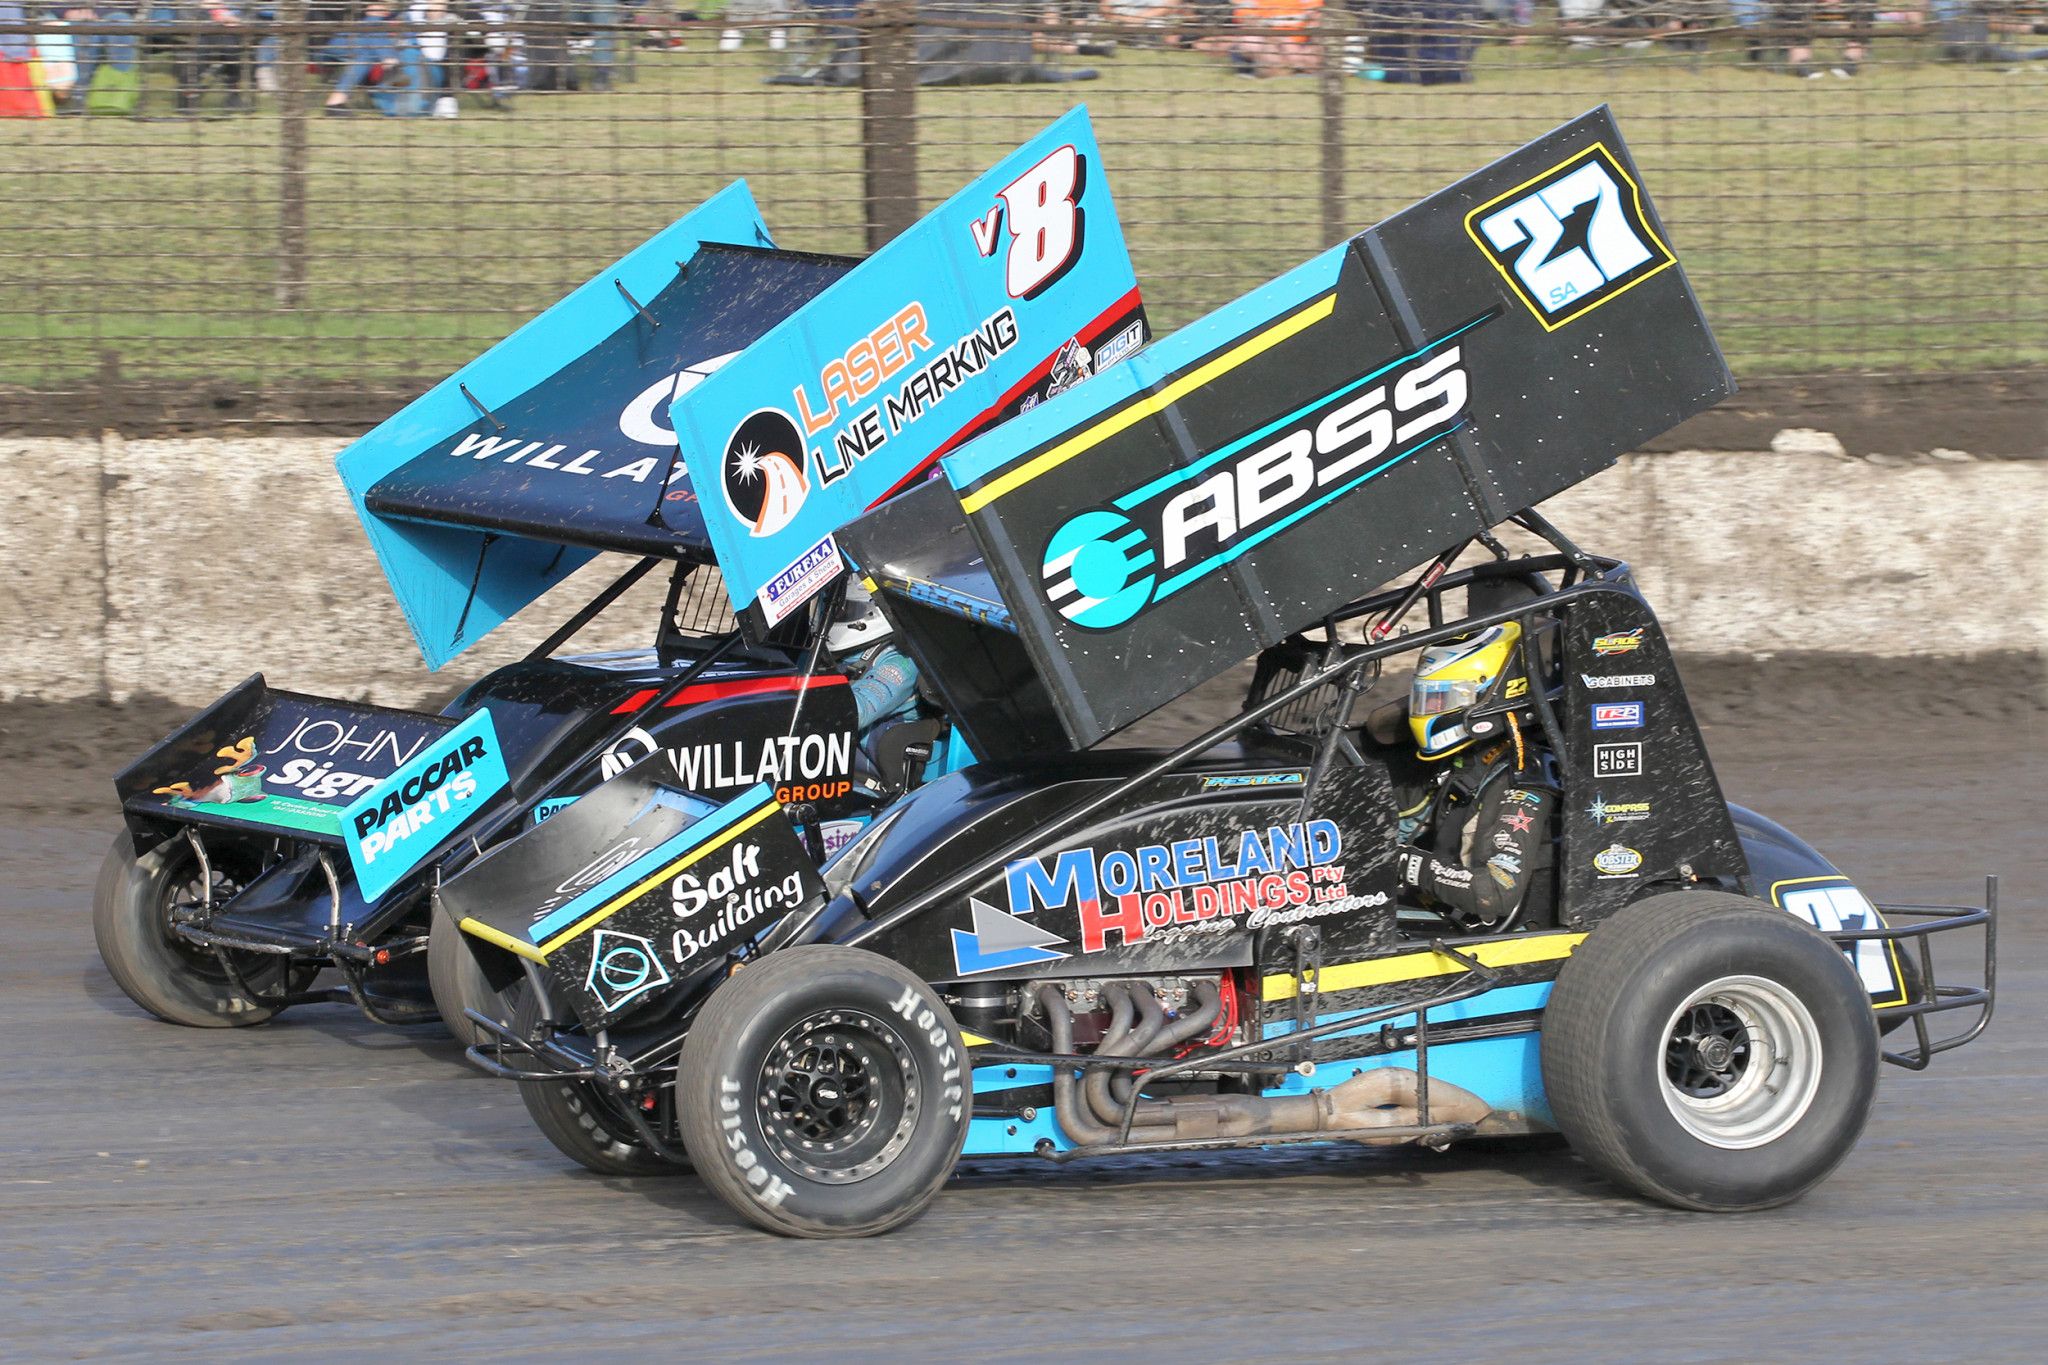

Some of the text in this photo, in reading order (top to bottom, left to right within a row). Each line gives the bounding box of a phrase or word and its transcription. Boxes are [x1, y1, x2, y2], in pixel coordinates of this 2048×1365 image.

[1479, 159, 1653, 314] 27
[1549, 280, 1578, 306] SA
[795, 302, 934, 434] LASER
[815, 308, 1018, 488] LINE MARKING
[1163, 345, 1467, 569] ABSS
[774, 543, 833, 595] EUREKA
[779, 583, 808, 607] Garages
[814, 560, 835, 579] Sheds
[265, 717, 426, 767] JOHN
[667, 731, 851, 791] WILLATON
[1600, 749, 1636, 761] HIGH
[1600, 759, 1636, 771] SIDE
[354, 736, 487, 840] PACCAR
[776, 781, 851, 804] GROUP
[1605, 803, 1650, 813] COMPASS
[360, 770, 477, 865] PARTS
[672, 842, 760, 917] Salt
[1005, 818, 1342, 914] MORELAND
[1312, 866, 1345, 885] Pty
[1314, 884, 1348, 904] Ltd
[672, 871, 803, 963] Building
[1080, 871, 1311, 954] HOLDINGS
[1139, 891, 1388, 945] Logging Contractors
